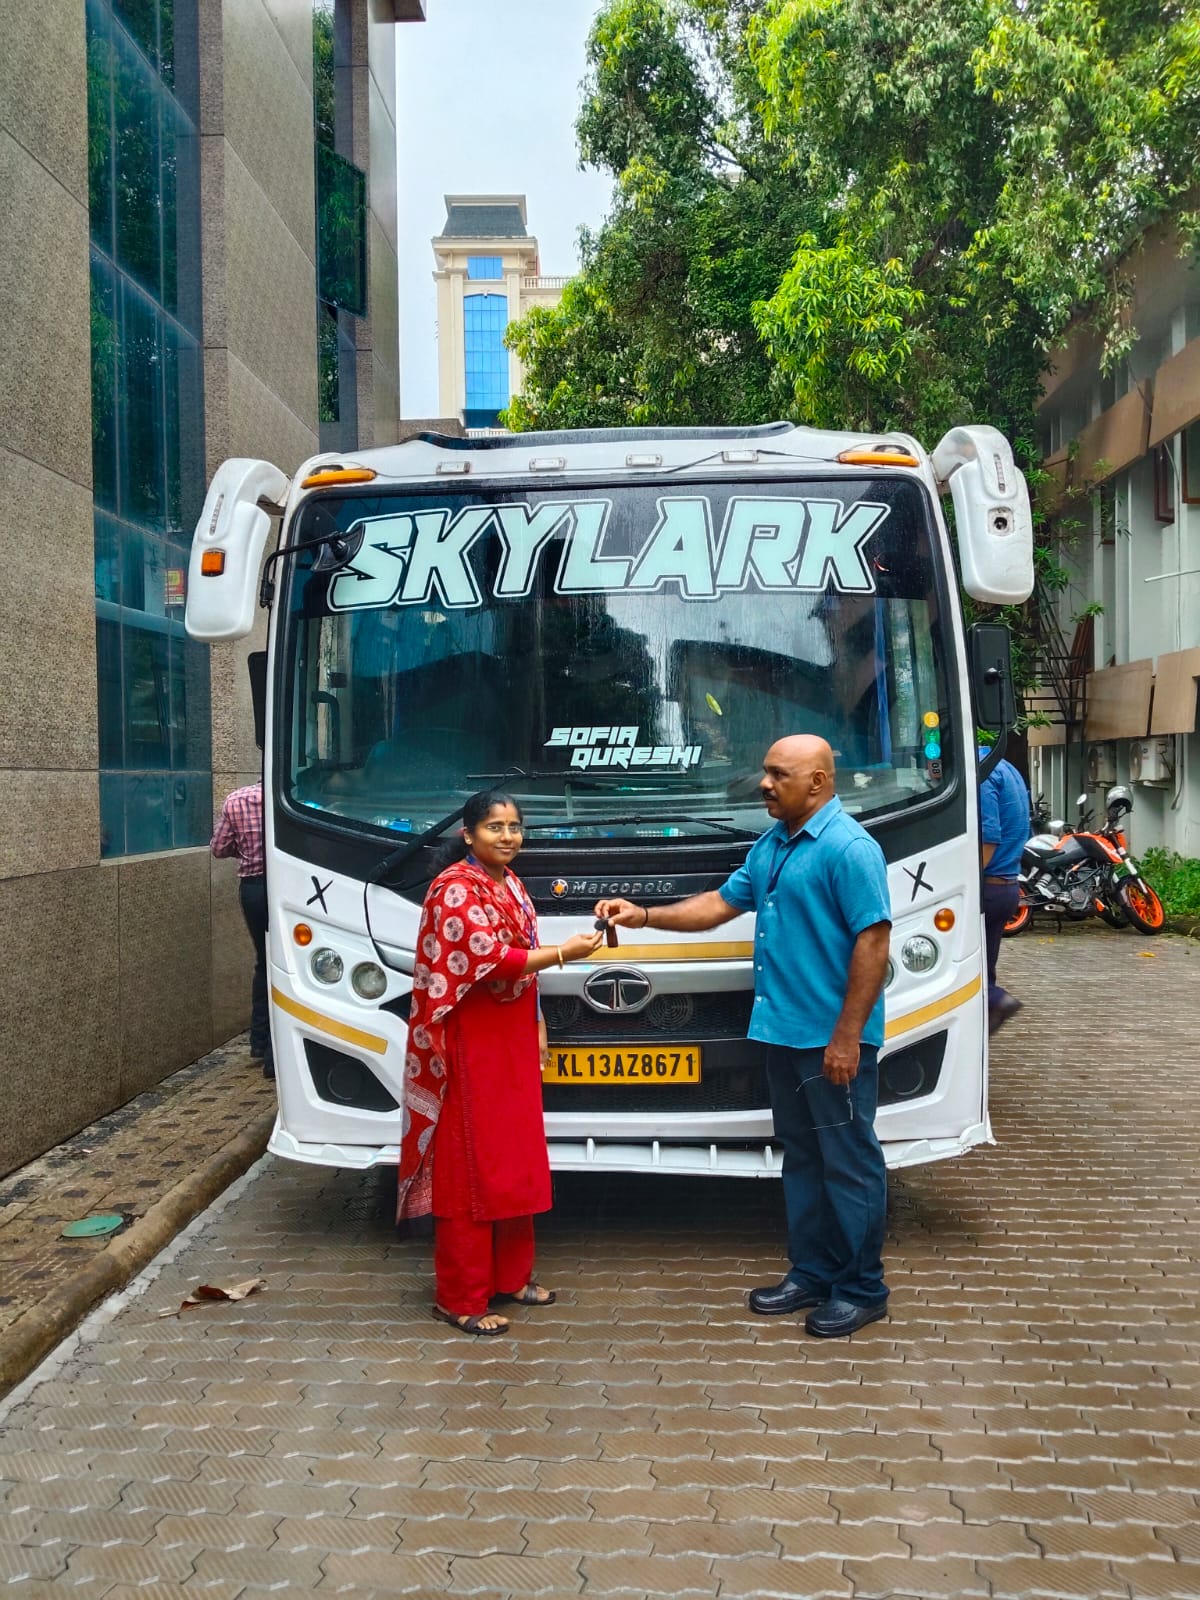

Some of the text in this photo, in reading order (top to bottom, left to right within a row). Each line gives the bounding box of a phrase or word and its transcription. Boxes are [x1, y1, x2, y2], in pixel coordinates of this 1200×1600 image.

[329, 496, 890, 612] SKYLARK
[544, 726, 640, 748] SOFIA
[570, 746, 702, 770] QURESHI
[572, 880, 674, 895] Marcopolo
[557, 1053, 695, 1077] KL13AZ8671
